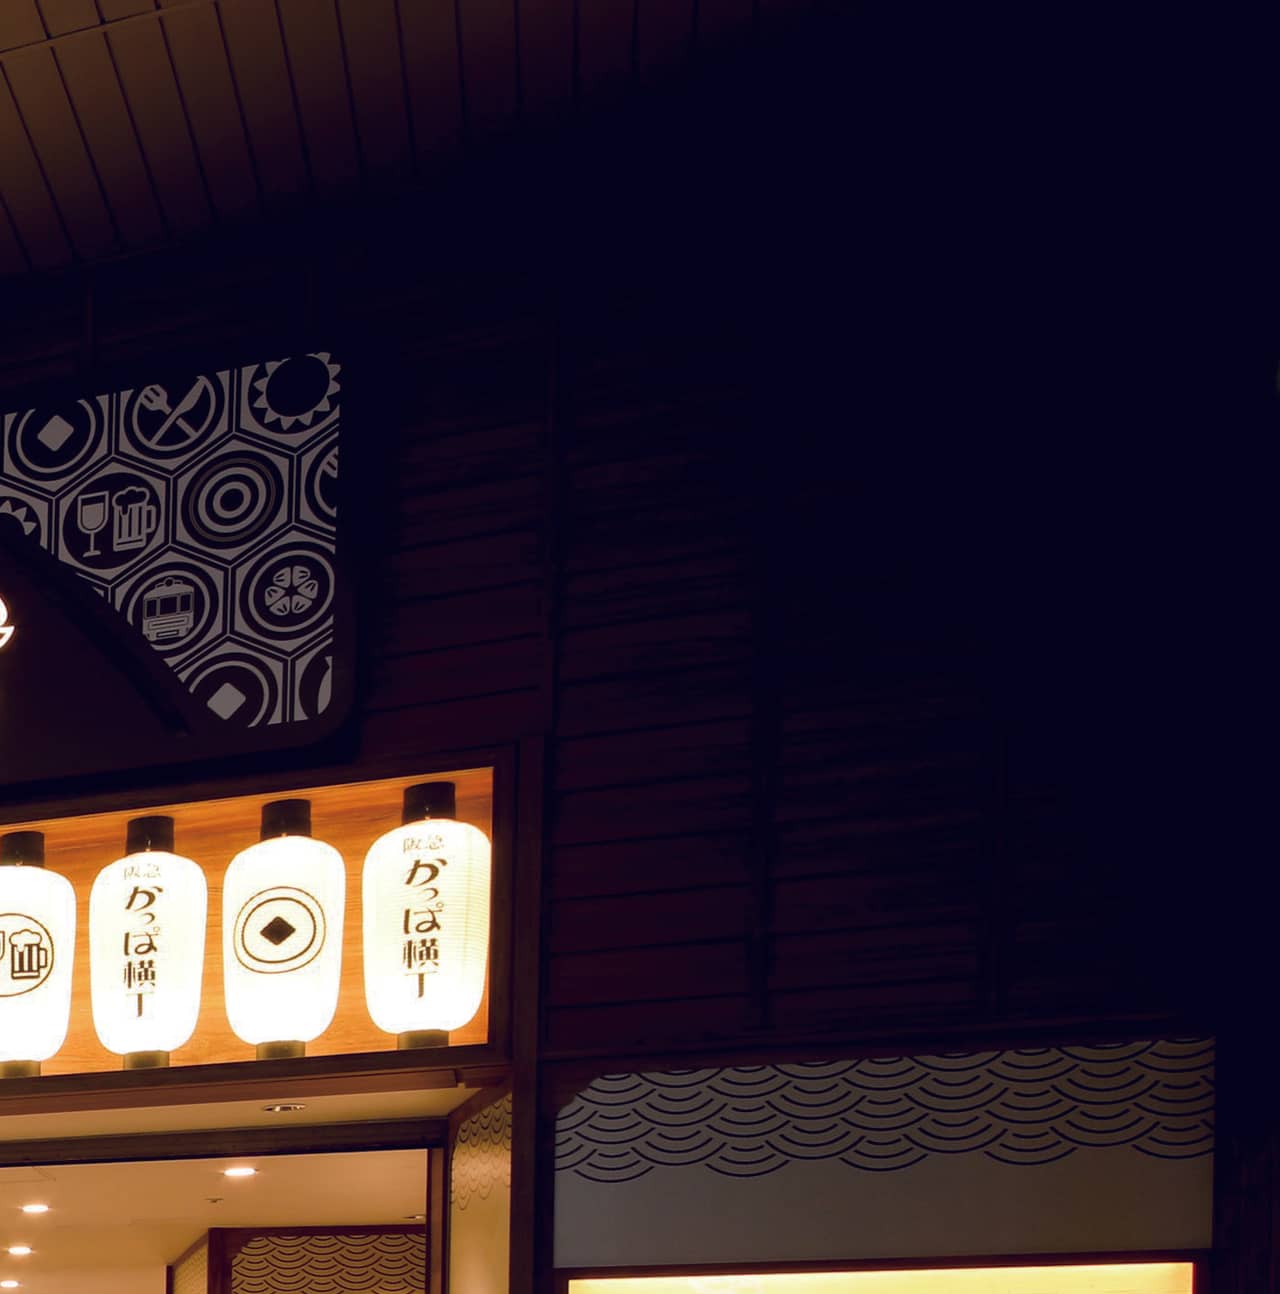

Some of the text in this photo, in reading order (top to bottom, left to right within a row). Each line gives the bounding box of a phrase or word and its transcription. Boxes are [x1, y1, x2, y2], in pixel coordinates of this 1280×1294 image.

[123, 885, 164, 1018] かっぱ横丁
[403, 858, 448, 998] かっぱ横丁
